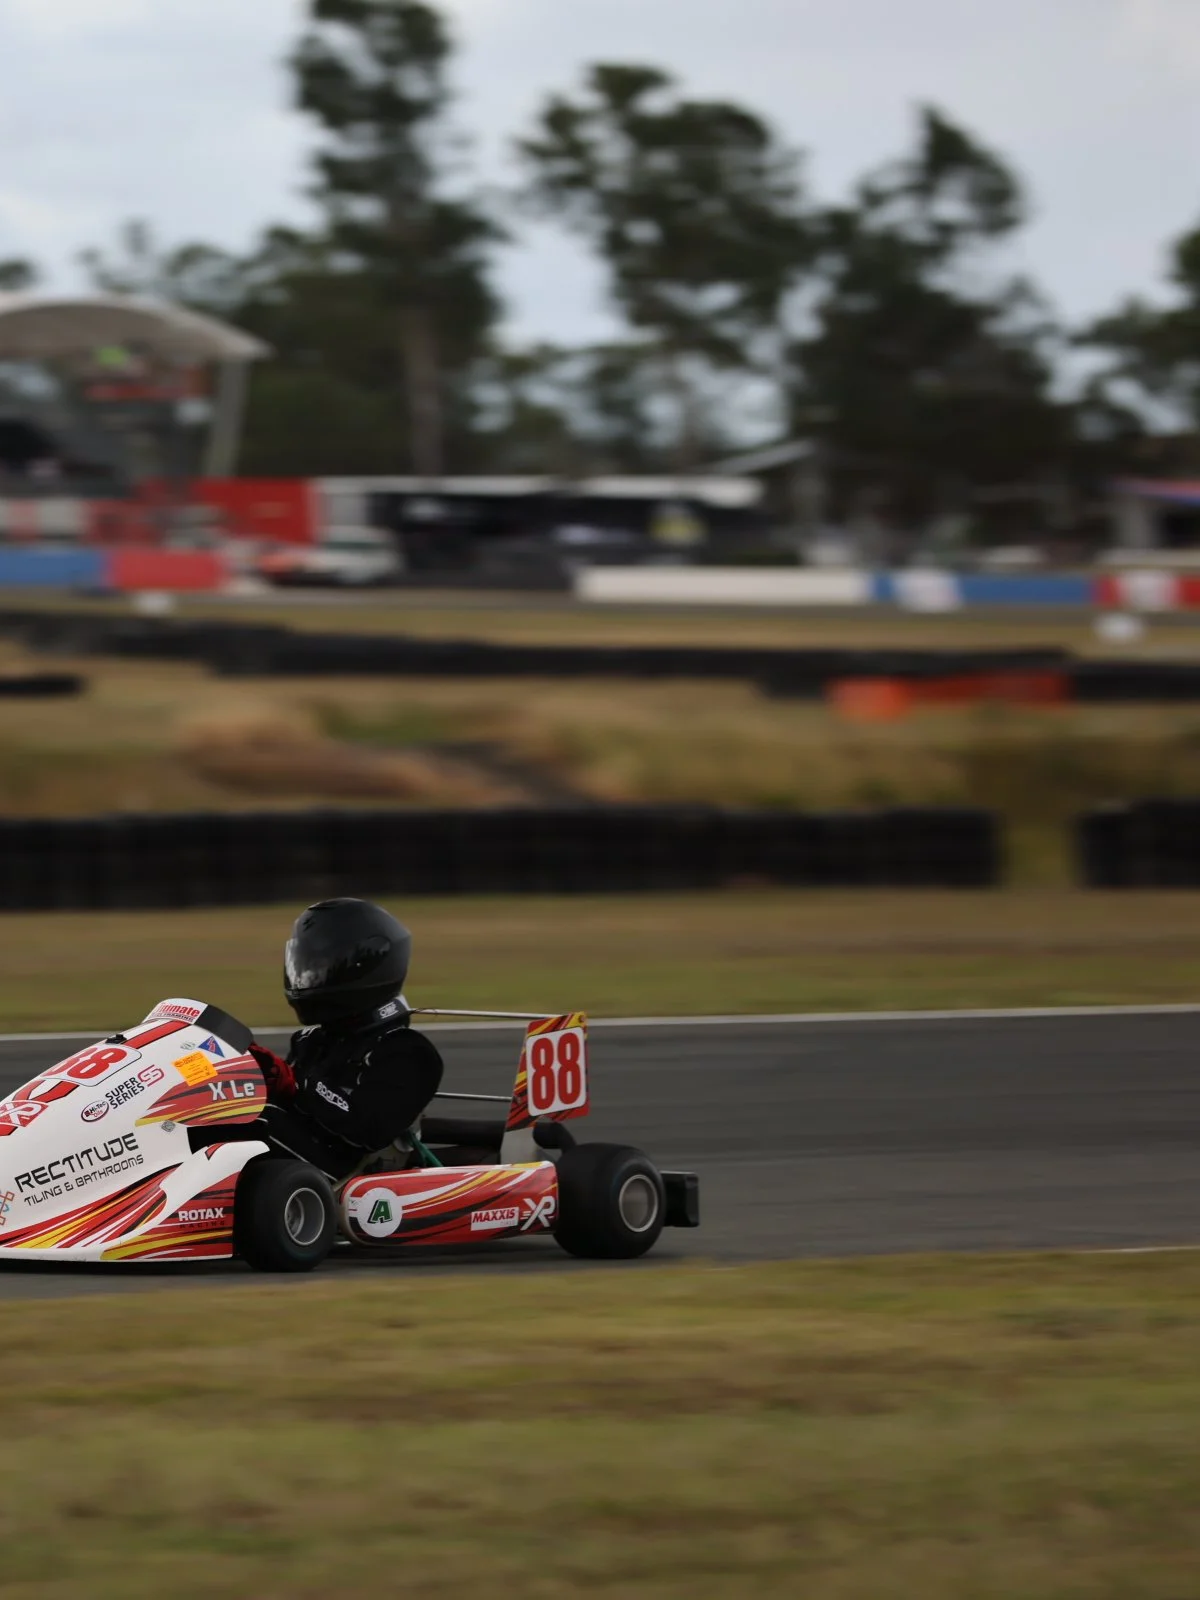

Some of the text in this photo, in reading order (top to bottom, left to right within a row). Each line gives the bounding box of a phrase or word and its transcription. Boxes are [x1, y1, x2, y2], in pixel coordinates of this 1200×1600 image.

[531, 1032, 582, 1110] 88
[105, 1077, 139, 1102] SUPER
[110, 1083, 145, 1110] SERIES
[208, 1080, 256, 1101] X Le
[316, 1082, 349, 1111] sparco
[14, 1132, 139, 1193] RECTITUDE
[24, 1154, 145, 1207] TILING & BATHROOMS
[178, 1207, 224, 1221] ROTAX
[367, 1199, 393, 1224] A
[472, 1209, 516, 1224] MAXXIS
